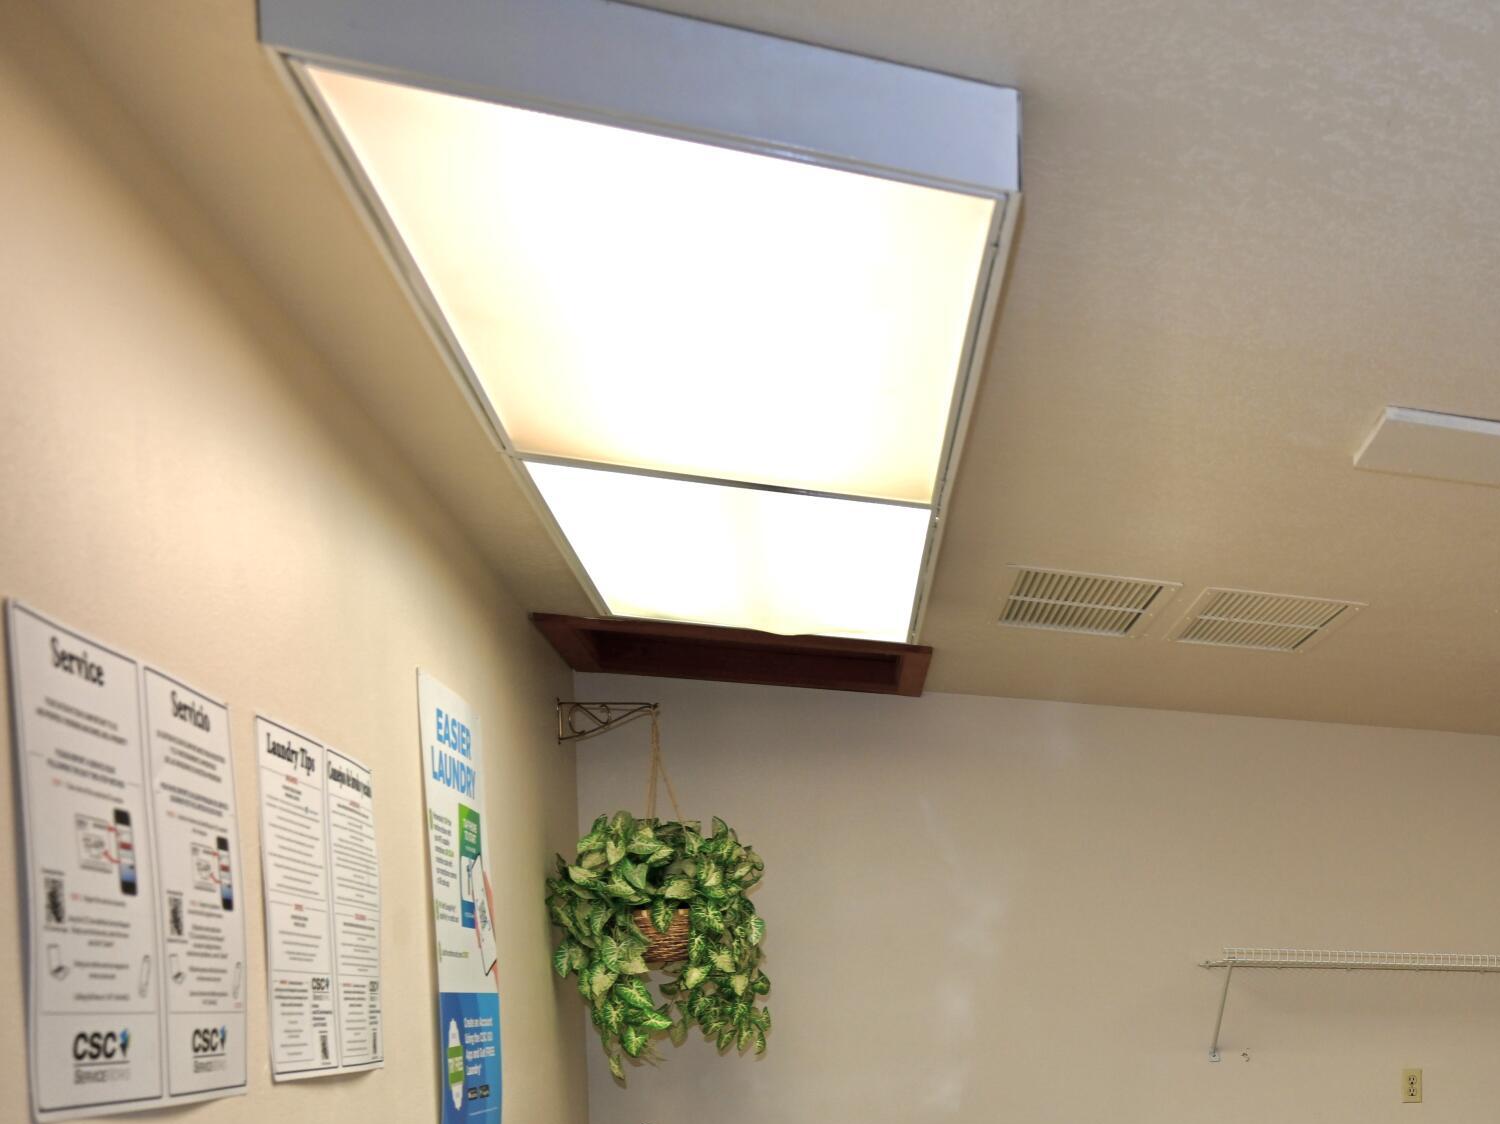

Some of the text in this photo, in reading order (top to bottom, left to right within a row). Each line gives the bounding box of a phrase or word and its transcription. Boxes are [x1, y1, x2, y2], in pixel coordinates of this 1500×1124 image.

[50, 636, 105, 687] Service
[170, 690, 211, 733] Servicio
[436, 707, 472, 759] EASIER
[266, 733, 316, 776] Laundry Tips
[431, 746, 476, 800] LAUNDRY
[73, 1032, 118, 1060] CSC
[192, 1028, 219, 1053] CSC
